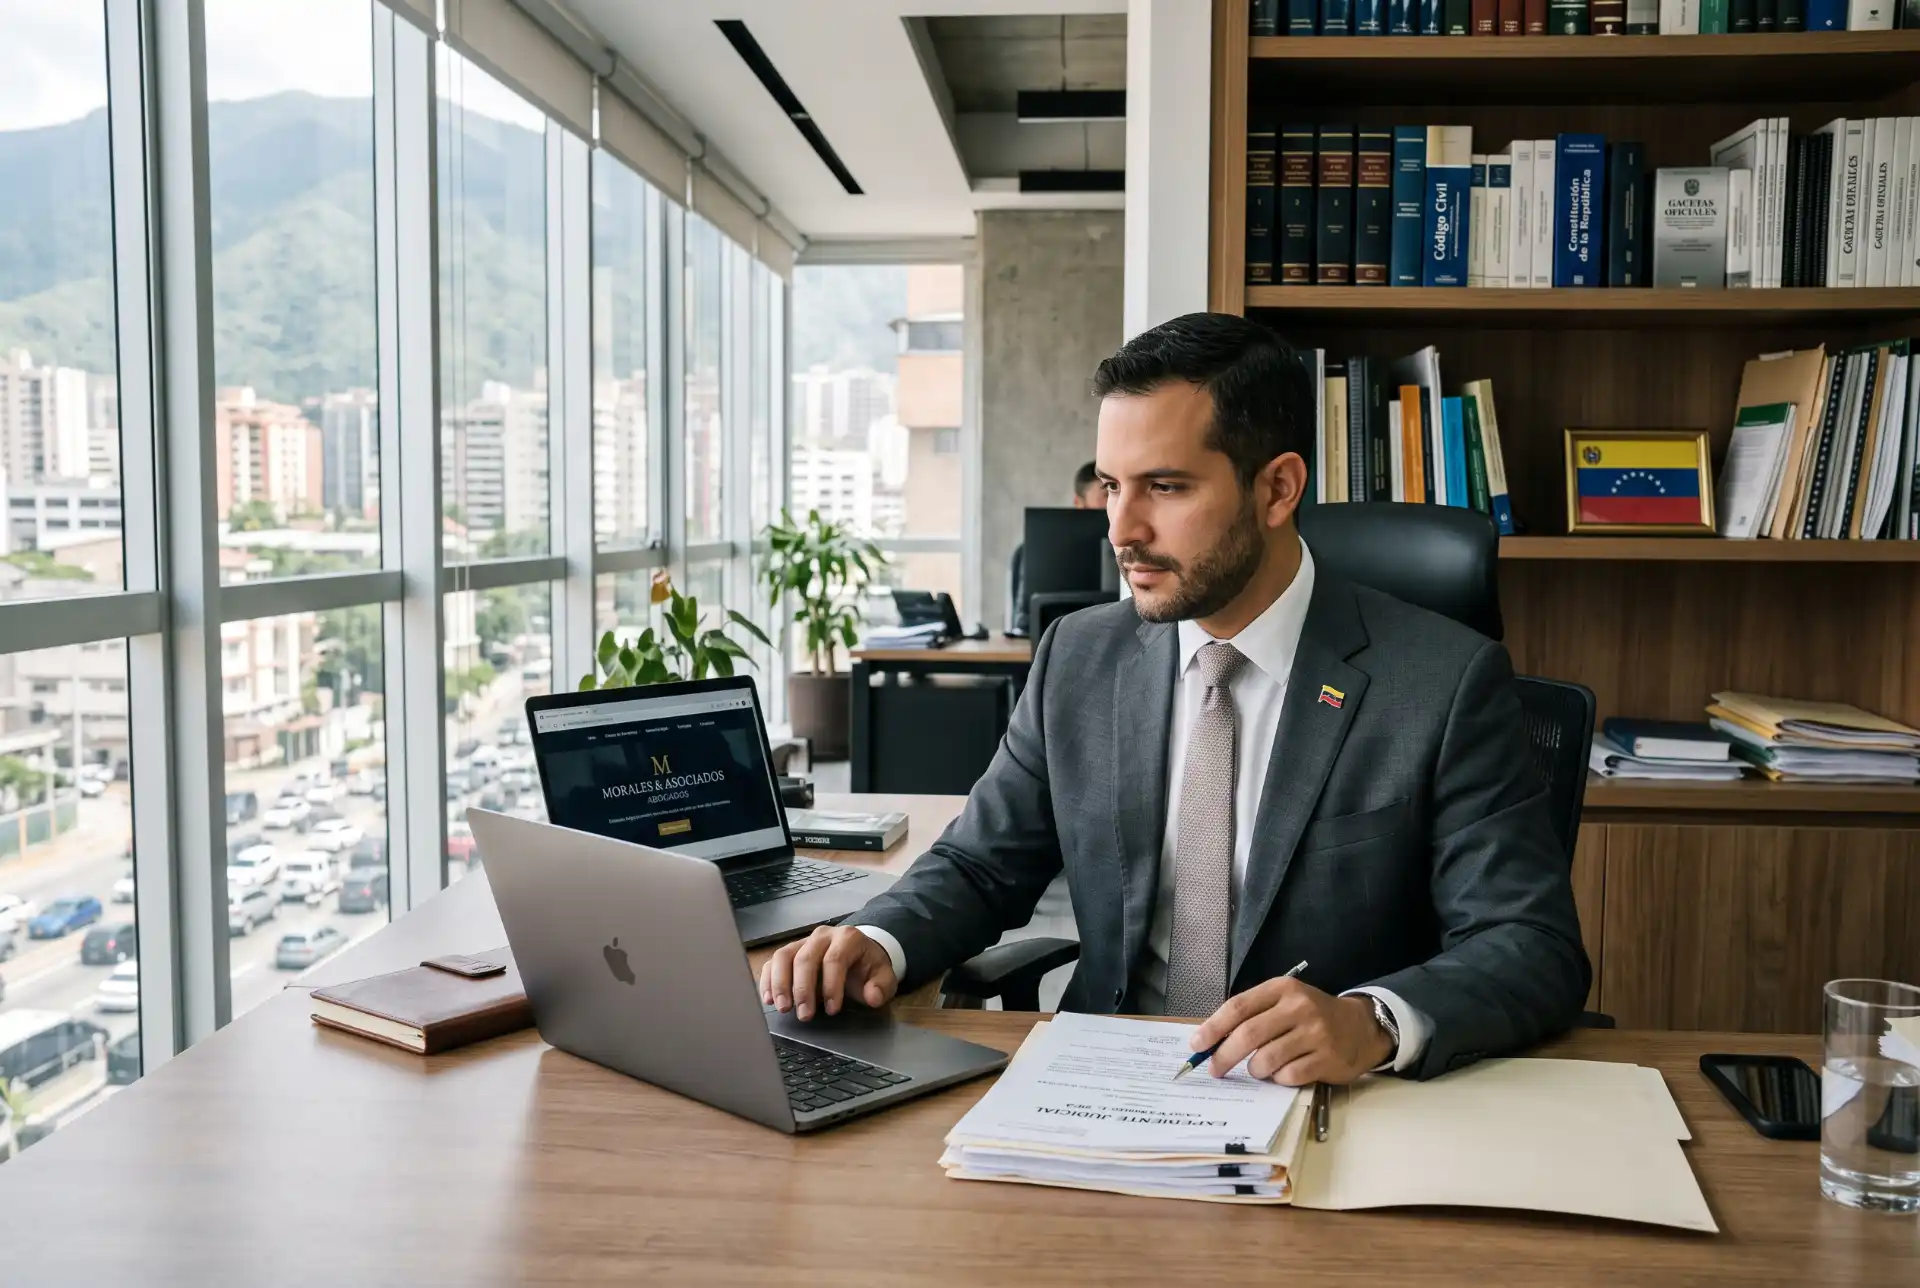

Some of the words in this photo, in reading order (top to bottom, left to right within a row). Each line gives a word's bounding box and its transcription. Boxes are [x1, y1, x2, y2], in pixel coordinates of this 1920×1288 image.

[1434, 182, 1448, 212] Civil
[1579, 168, 1592, 229] República
[1668, 199, 1714, 208] GACETAS
[1568, 177, 1580, 252] Constitución
[1664, 208, 1717, 216] OFICIALES
[1433, 215, 1450, 261] Código
[1579, 232, 1589, 243] la
[1579, 246, 1589, 262] de
[650, 755, 673, 776] M
[602, 780, 654, 799] MORALES
[655, 780, 663, 791] &
[665, 770, 725, 789] ASOCIADOS
[647, 790, 690, 804] ABOGADOS
[1036, 1106, 1112, 1120] JUDICIAL
[1121, 1115, 1228, 1127] EXPEDIENTE
